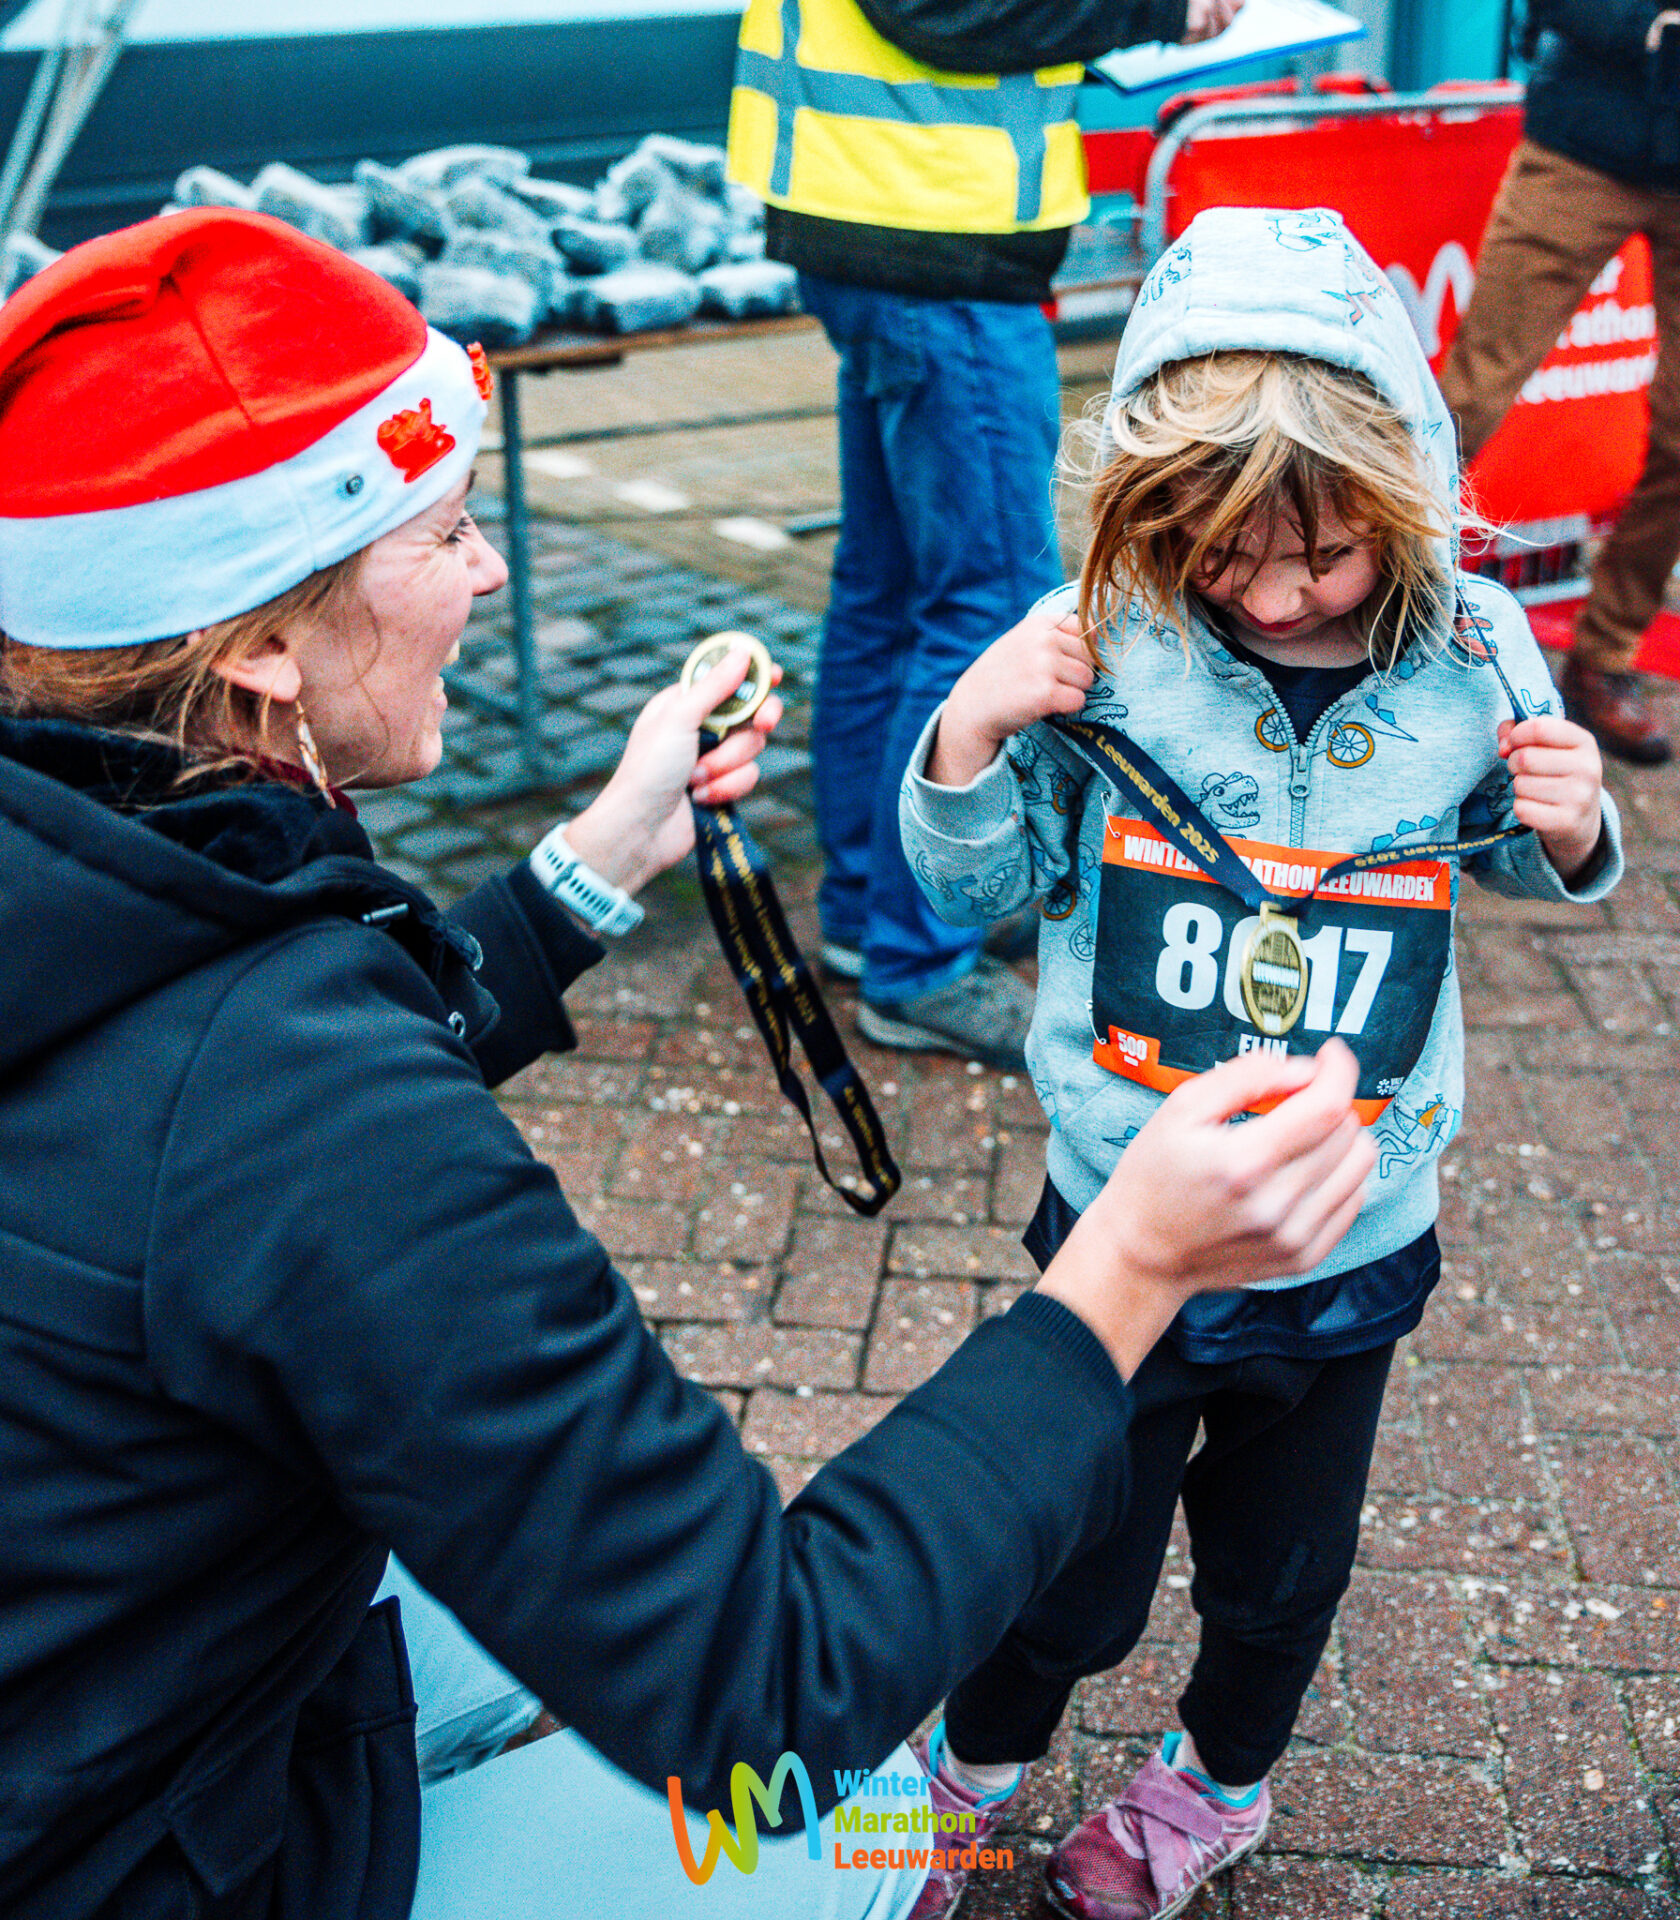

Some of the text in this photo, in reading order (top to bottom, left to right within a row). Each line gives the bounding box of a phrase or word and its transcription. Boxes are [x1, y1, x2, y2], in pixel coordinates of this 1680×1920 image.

[1556, 299, 1656, 350] athon
[1096, 735, 1220, 864] Leeuwarden 2025
[1239, 855, 1317, 891] ATHON
[1117, 1031, 1148, 1061] 500
